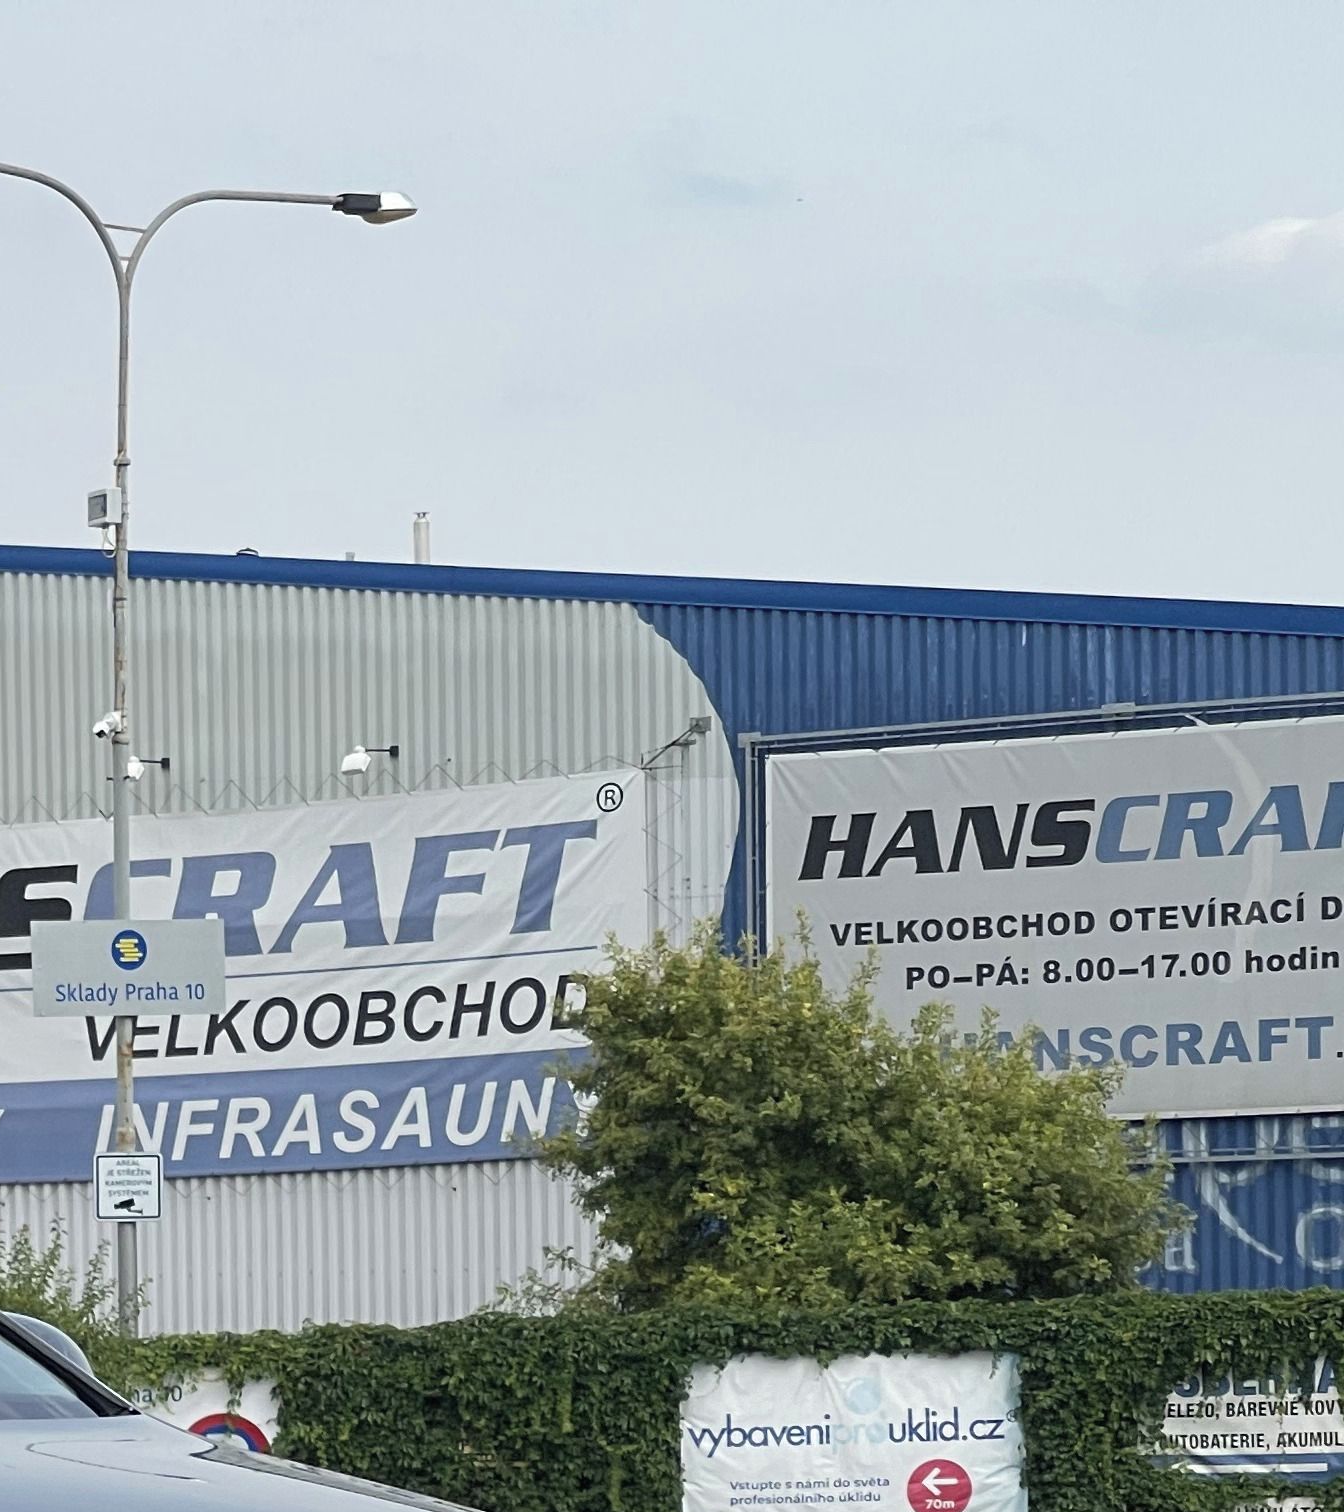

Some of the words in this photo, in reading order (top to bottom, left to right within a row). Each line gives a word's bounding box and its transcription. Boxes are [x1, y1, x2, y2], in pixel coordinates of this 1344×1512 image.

[830, 910, 1096, 947] VELKOOBCHOD
[1109, 891, 1305, 932] OTEVÍRACÍ
[1245, 946, 1339, 974] hodin
[55, 982, 118, 1006] Sklady
[125, 981, 179, 1001] Praha
[185, 983, 205, 1000] 10
[85, 974, 591, 1061] VELKOOBCHOD
[940, 1016, 1344, 1072] NSCRAFT.
[1169, 1433, 1270, 1450] UTOBATERIE,
[730, 1481, 781, 1491] Vstupte
[785, 1481, 792, 1489] s
[796, 1479, 829, 1489] námi
[833, 1478, 850, 1488] do
[854, 1477, 889, 1488] světa
[730, 1493, 834, 1506] profesionálního
[839, 1492, 881, 1502] úklidu
[925, 1499, 955, 1509] 70m
